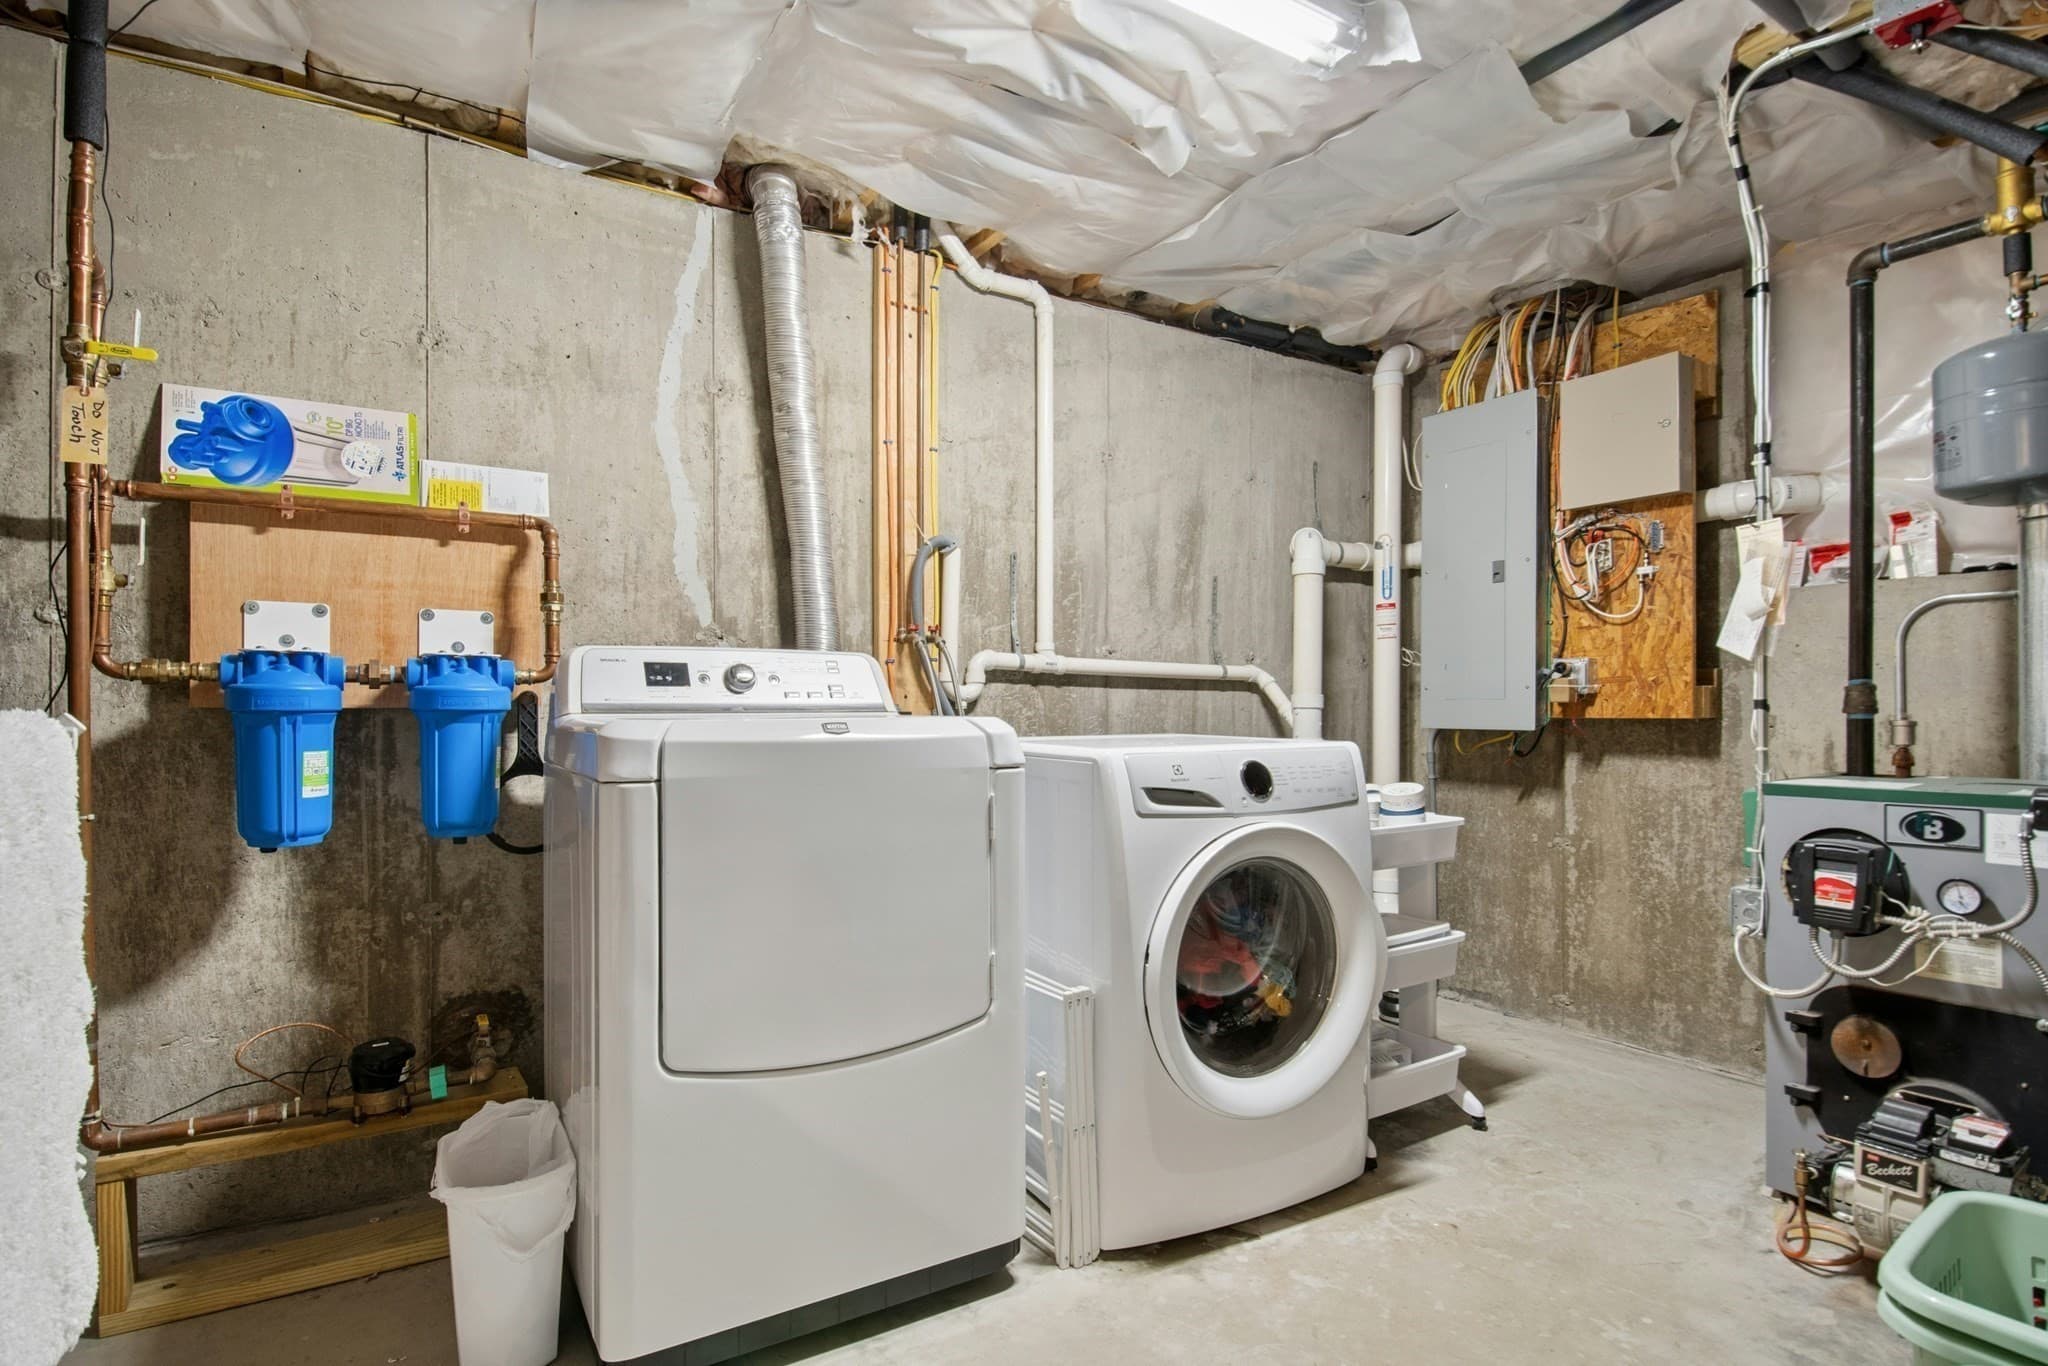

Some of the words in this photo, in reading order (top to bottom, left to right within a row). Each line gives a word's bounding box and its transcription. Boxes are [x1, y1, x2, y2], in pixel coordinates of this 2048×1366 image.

[69, 402, 86, 444] Touch
[396, 426, 404, 445] FILTRI
[395, 446, 405, 470] ATLAS
[1865, 1162, 1913, 1176] Beckett
